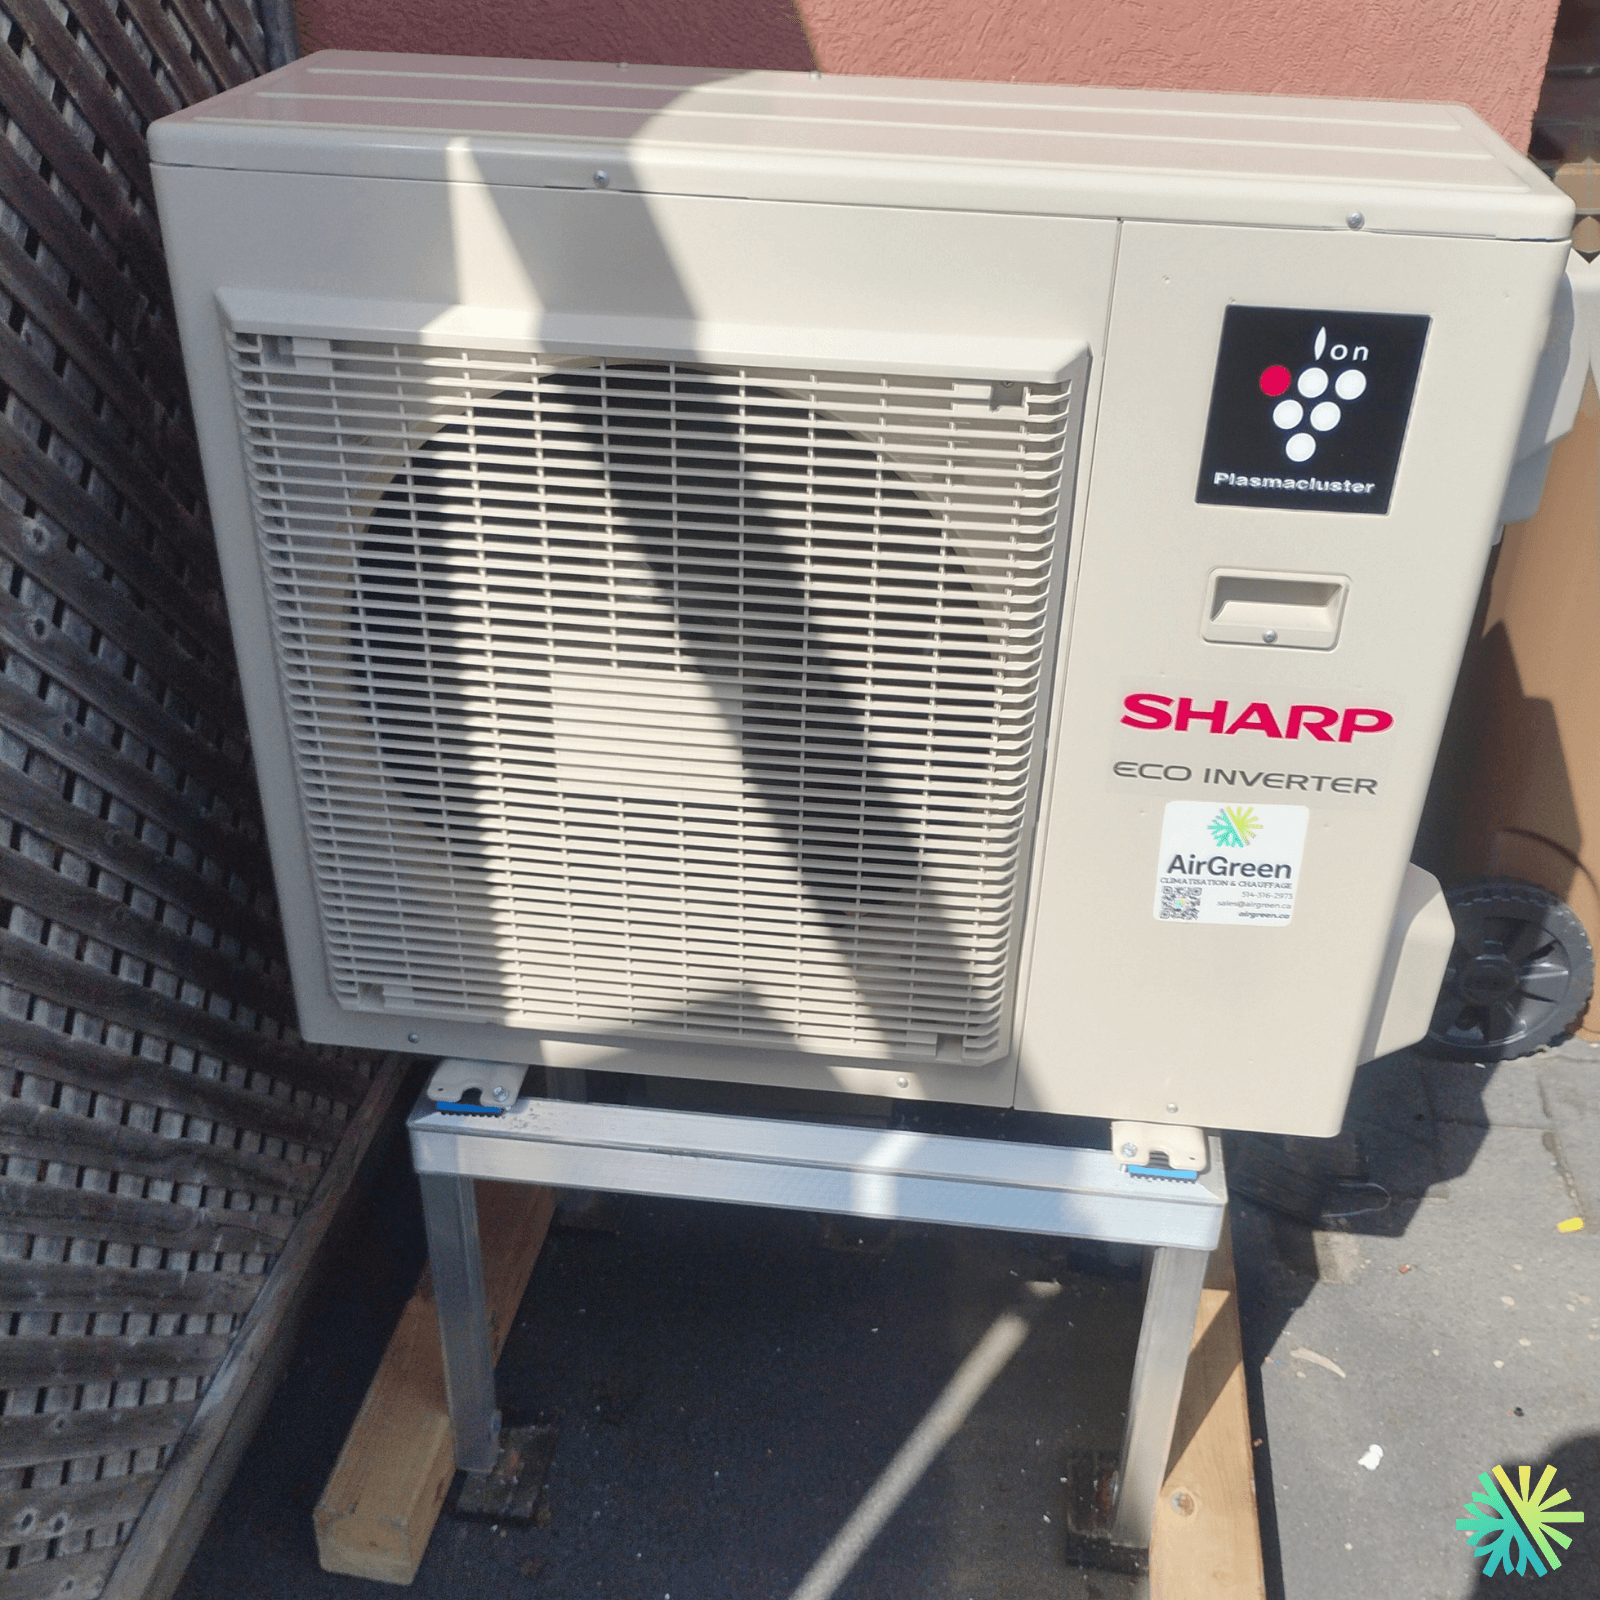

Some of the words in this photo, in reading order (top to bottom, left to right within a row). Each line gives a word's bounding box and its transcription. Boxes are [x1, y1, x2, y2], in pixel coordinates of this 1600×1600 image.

[1314, 326, 1370, 362] Ion
[1213, 472, 1376, 494] Plasmacluster
[1120, 693, 1395, 743] SHARP
[1112, 761, 1192, 782] ECO
[1203, 768, 1379, 796] INVERTER
[1166, 854, 1293, 880] AirGreen
[1159, 877, 1229, 887] CLIMATISATION
[1238, 880, 1293, 890] CHAUFFAGE
[1216, 900, 1292, 910] sales@airgreen.ca
[1238, 910, 1291, 920] airgreen.ca
